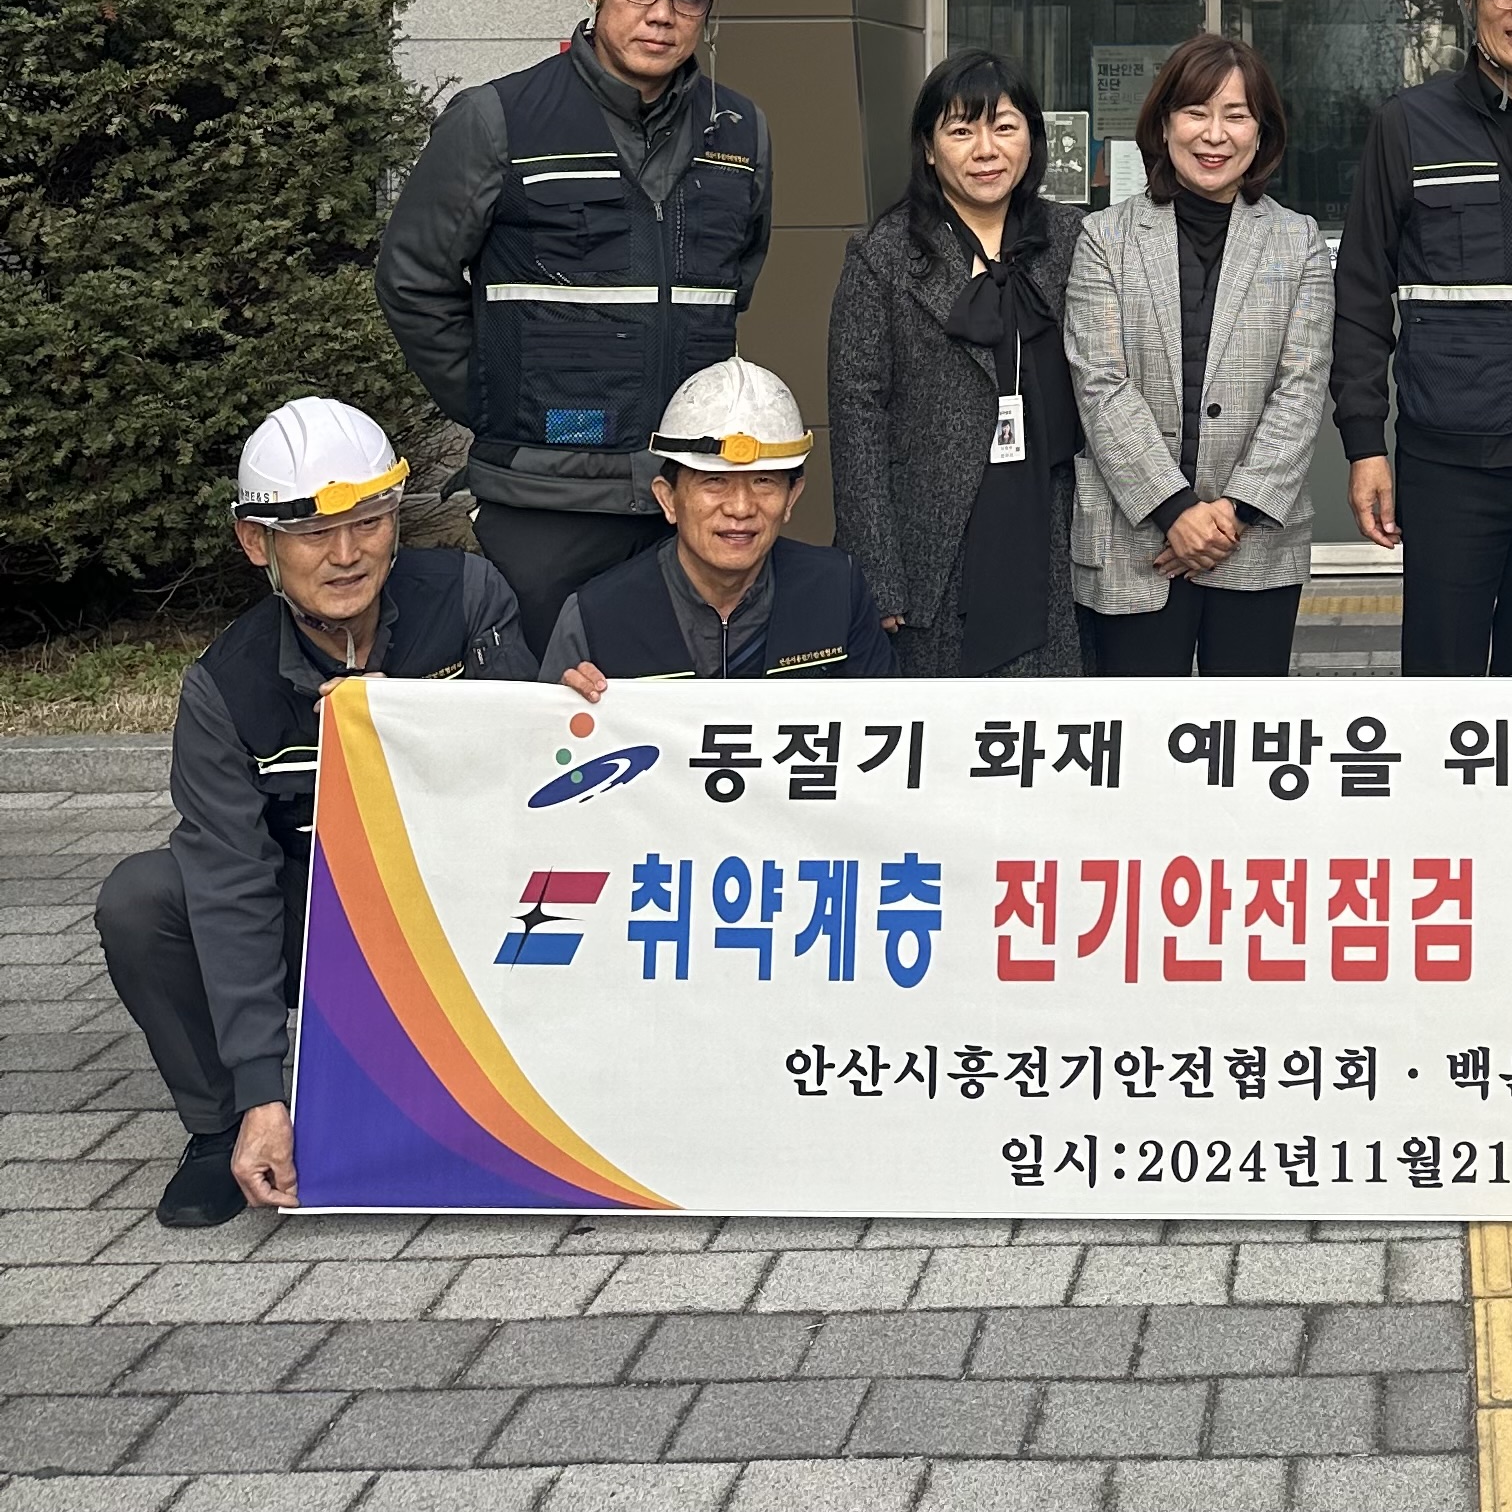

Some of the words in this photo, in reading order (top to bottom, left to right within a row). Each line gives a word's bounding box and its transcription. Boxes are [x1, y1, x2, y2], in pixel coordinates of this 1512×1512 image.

[1097, 63, 1145, 76] 재난안전
[1097, 78, 1121, 91] 진단
[689, 721, 924, 803] 동절기
[970, 720, 1122, 788] 화재
[1168, 716, 1402, 801] 예방을
[627, 852, 943, 989] 취약계층
[994, 855, 1473, 984] 전기안전점검
[786, 1044, 1377, 1102] 안산시흥전기안전협의회
